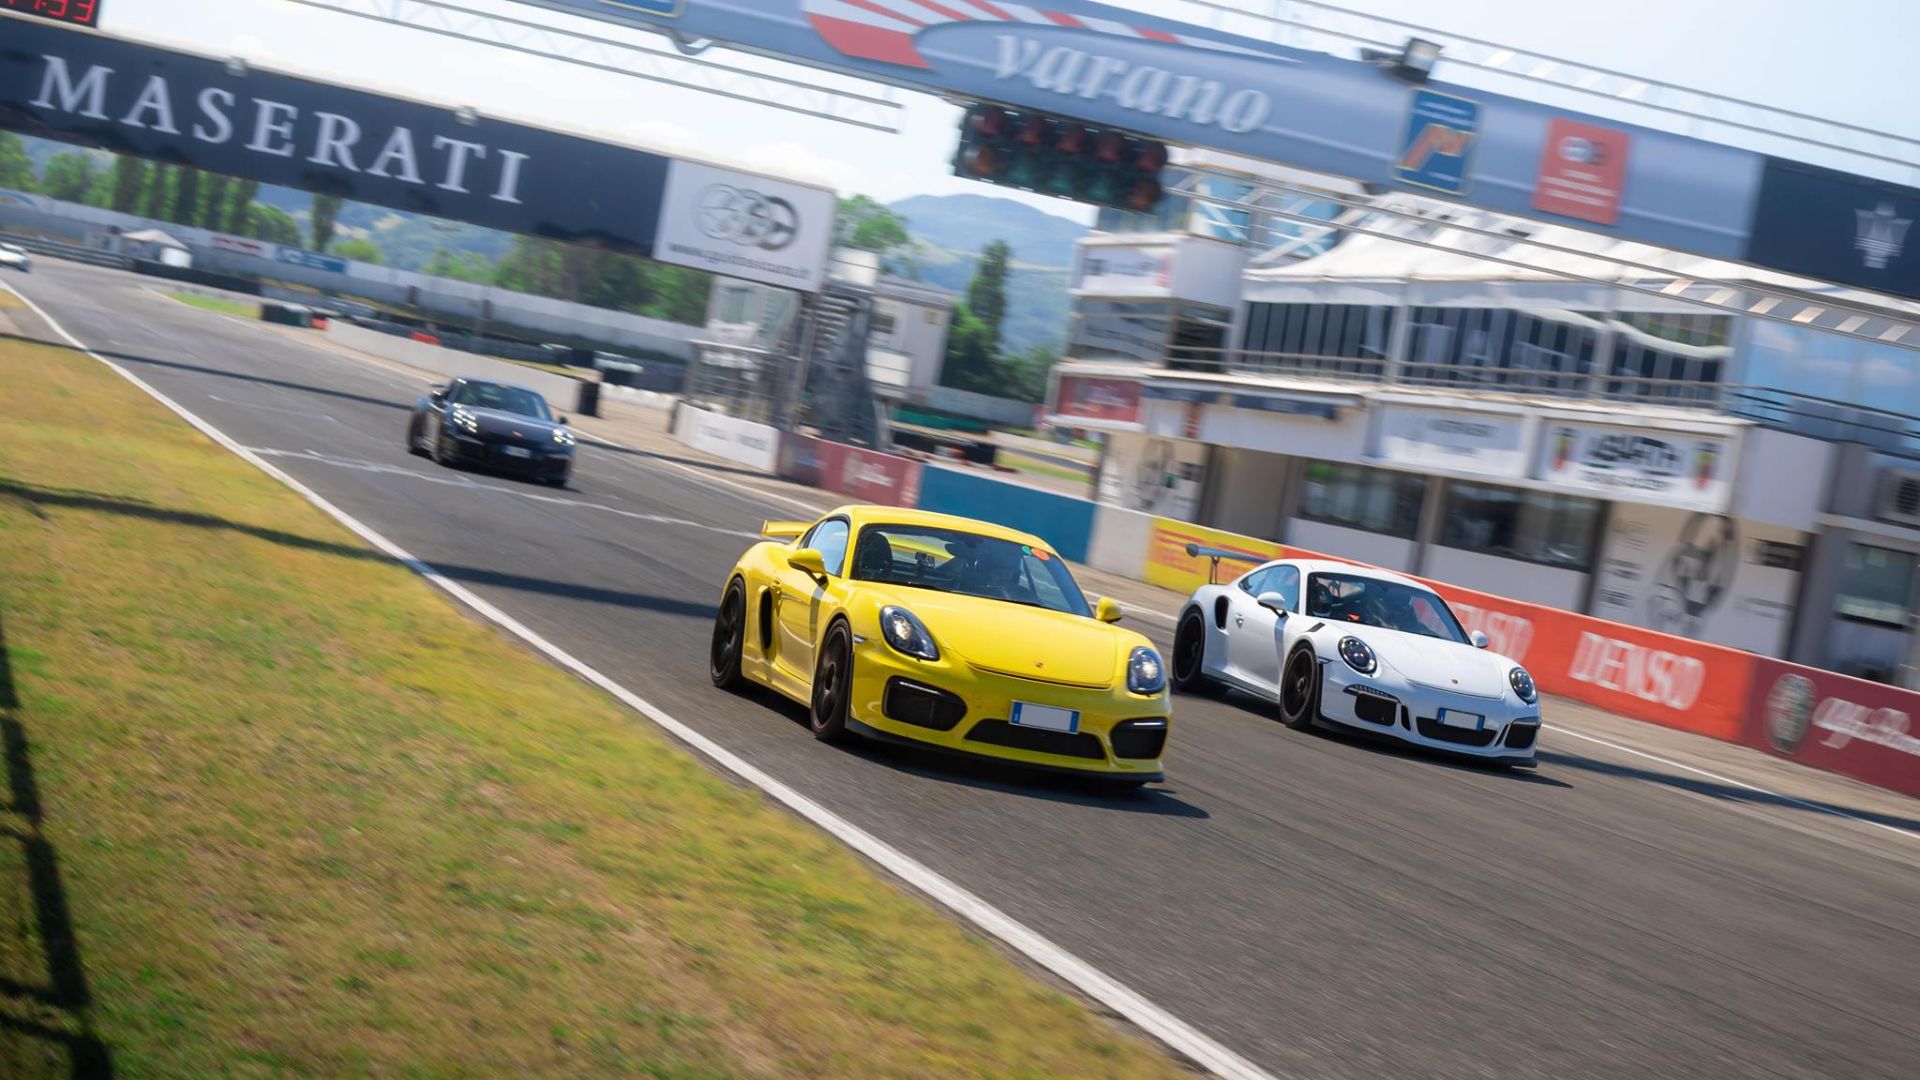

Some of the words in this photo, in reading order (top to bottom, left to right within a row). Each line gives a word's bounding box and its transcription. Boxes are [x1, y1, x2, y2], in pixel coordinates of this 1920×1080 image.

[30, 54, 530, 204] MASERATI
[993, 35, 1271, 133] varano
[1568, 631, 1706, 711] DENSO
